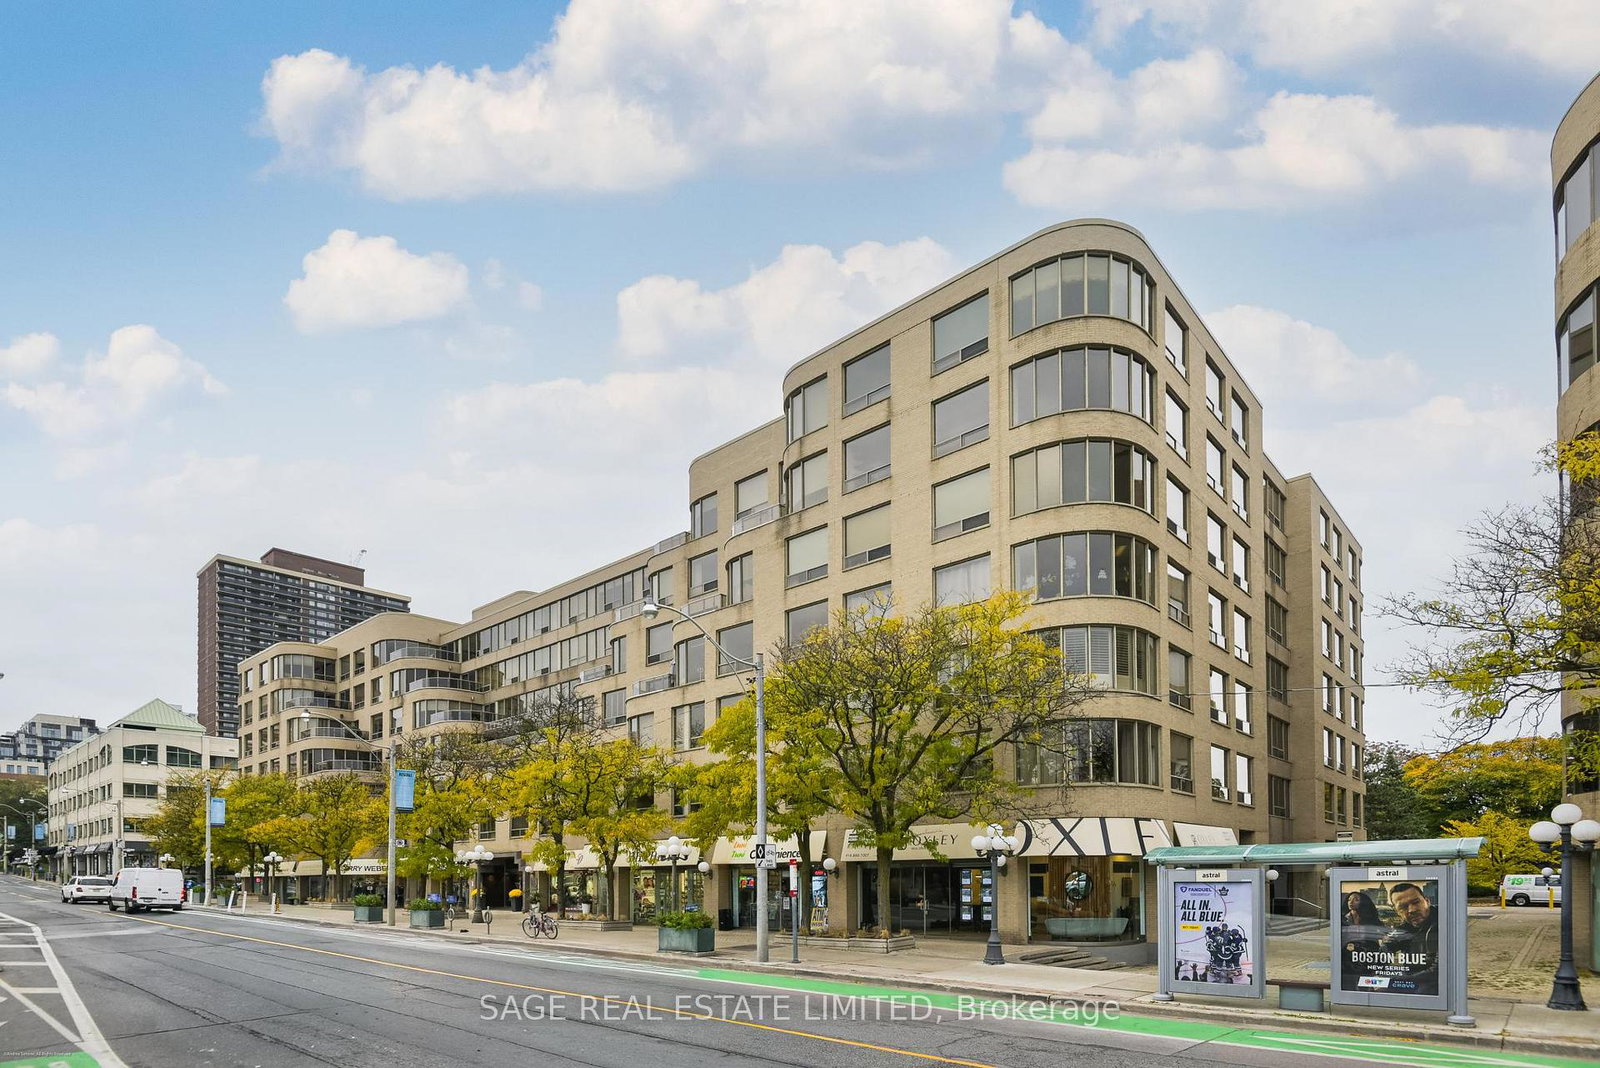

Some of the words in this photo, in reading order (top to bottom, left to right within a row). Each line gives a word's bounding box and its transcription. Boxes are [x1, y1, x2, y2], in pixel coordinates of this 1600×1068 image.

[1181, 899, 1196, 910] ALL
[1199, 899, 1211, 910] IN.
[1181, 911, 1196, 921] ALL
[1199, 911, 1224, 922] BLUE.
[1352, 951, 1394, 964] BOSTON
[1398, 952, 1427, 965] BLUE
